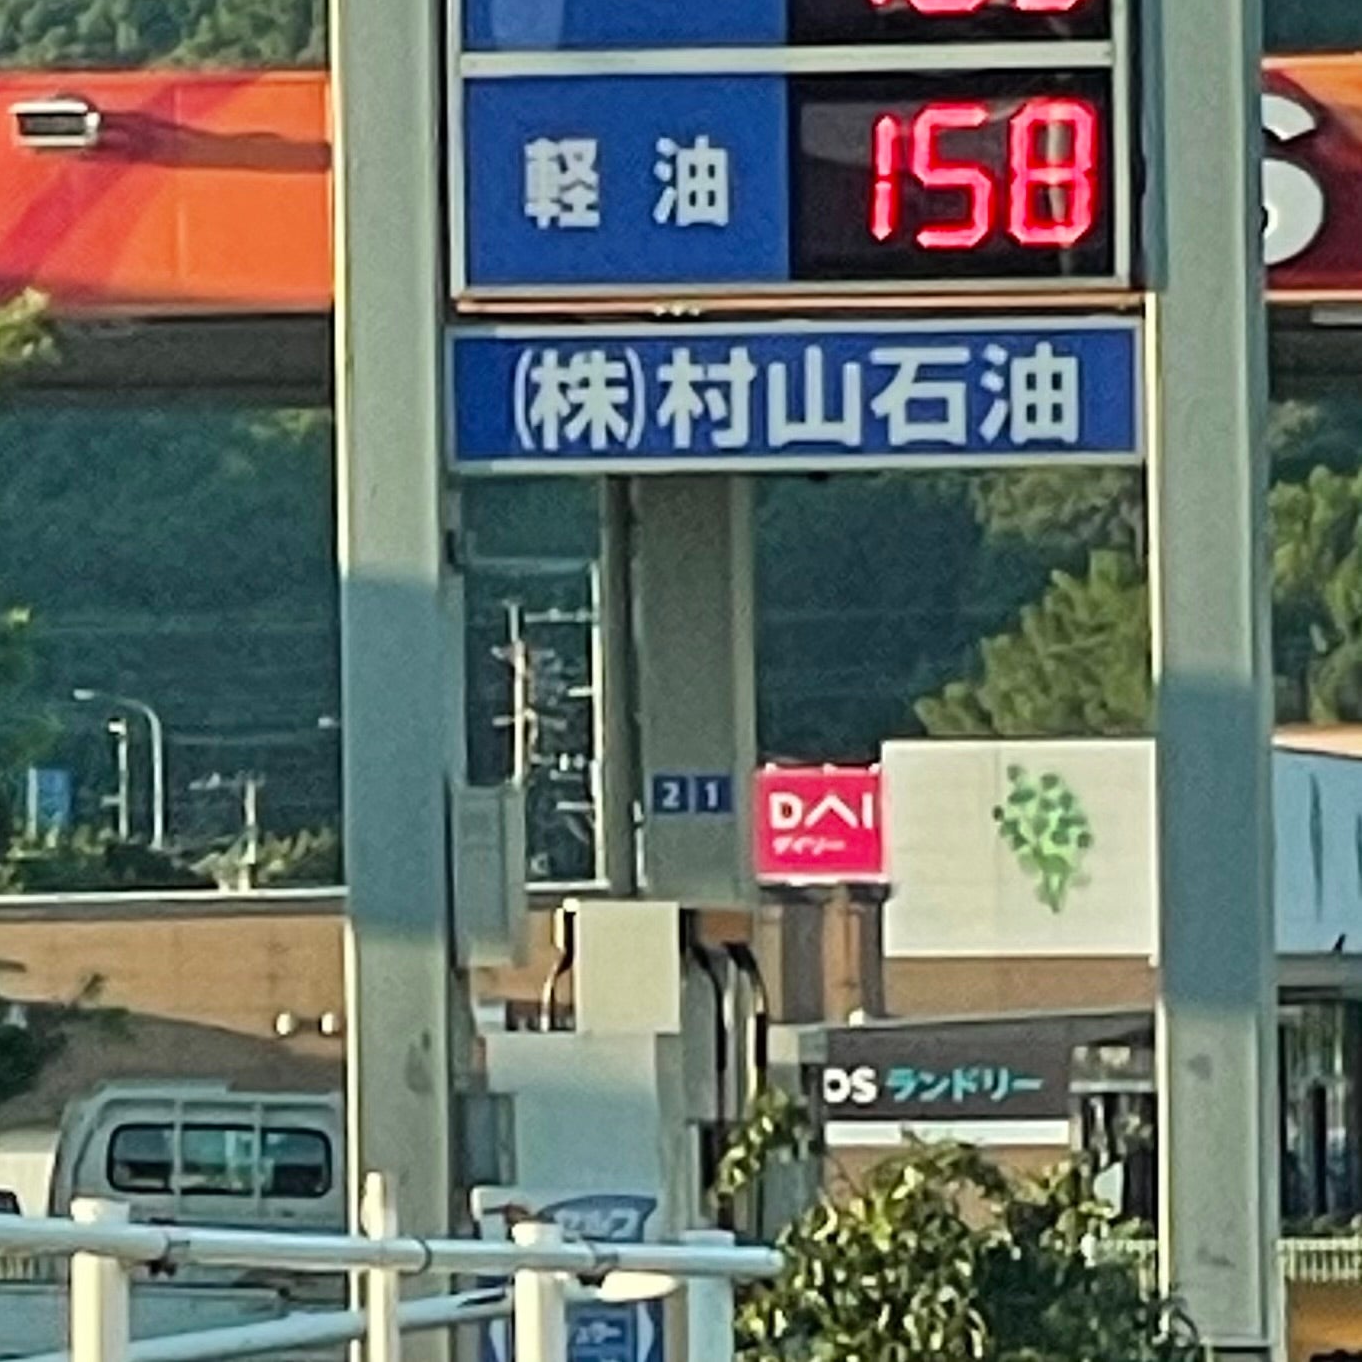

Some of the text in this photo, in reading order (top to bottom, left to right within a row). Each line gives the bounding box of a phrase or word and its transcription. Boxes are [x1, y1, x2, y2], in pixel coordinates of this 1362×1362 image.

[870, 99, 1099, 250] 158
[885, 1068, 1045, 1103] ランドリー
